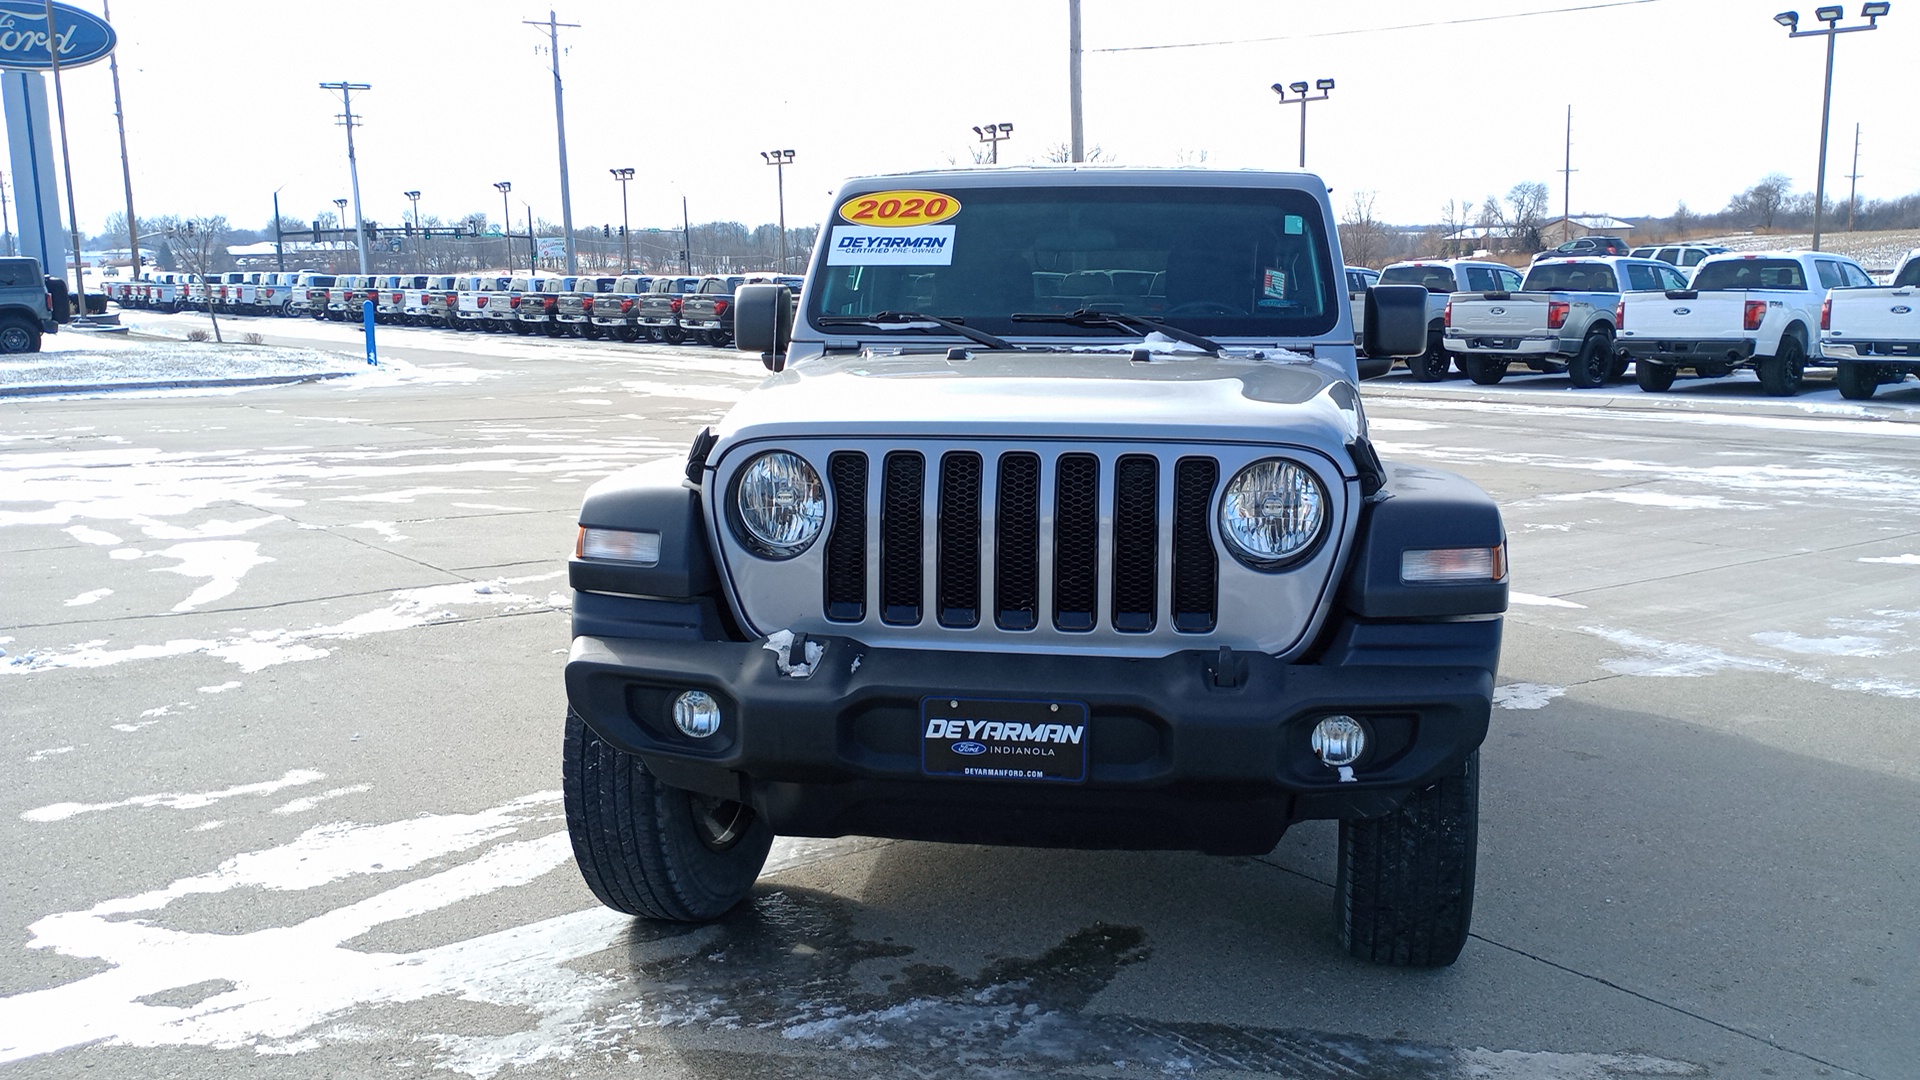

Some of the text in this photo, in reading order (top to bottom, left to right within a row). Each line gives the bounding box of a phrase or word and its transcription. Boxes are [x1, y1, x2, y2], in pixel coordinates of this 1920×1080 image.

[851, 198, 948, 219] 2020
[838, 236, 947, 248] DEYARMAN
[925, 719, 1084, 744] DEYARMAN
[990, 745, 1055, 756] INDIANOLA
[964, 767, 1044, 778] DEYARMANFORD.COM
